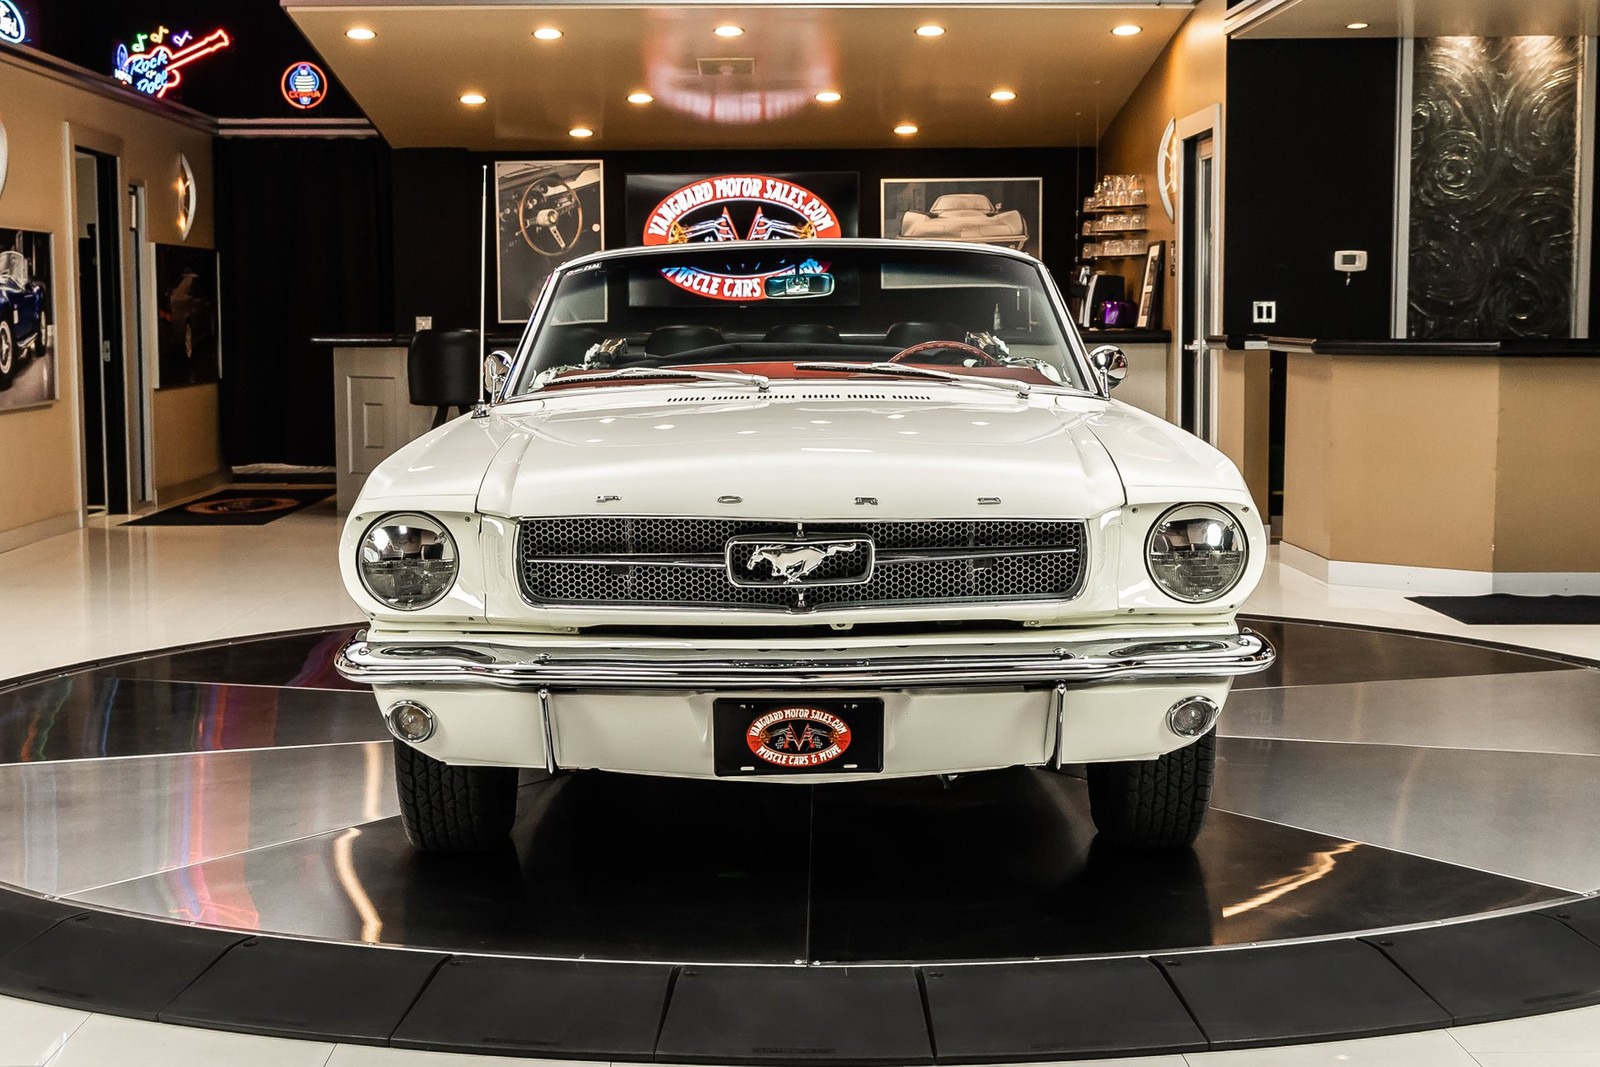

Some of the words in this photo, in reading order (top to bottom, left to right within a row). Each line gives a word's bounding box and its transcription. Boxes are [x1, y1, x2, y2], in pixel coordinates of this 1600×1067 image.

[130, 49, 168, 75] Rock
[648, 180, 714, 237] VANGUARD
[714, 177, 762, 199] MOTOR
[763, 179, 835, 232] SALES.COM
[661, 266, 721, 296] MUSCLE
[722, 278, 762, 298] CARS
[749, 711, 784, 737] VANGUARD
[784, 708, 809, 719] MOTOR
[810, 709, 848, 735] SALES.COM
[756, 746, 786, 765] MUSCLE
[788, 755, 809, 766] CARS
[811, 754, 818, 764] &
[820, 745, 842, 762] MORE
